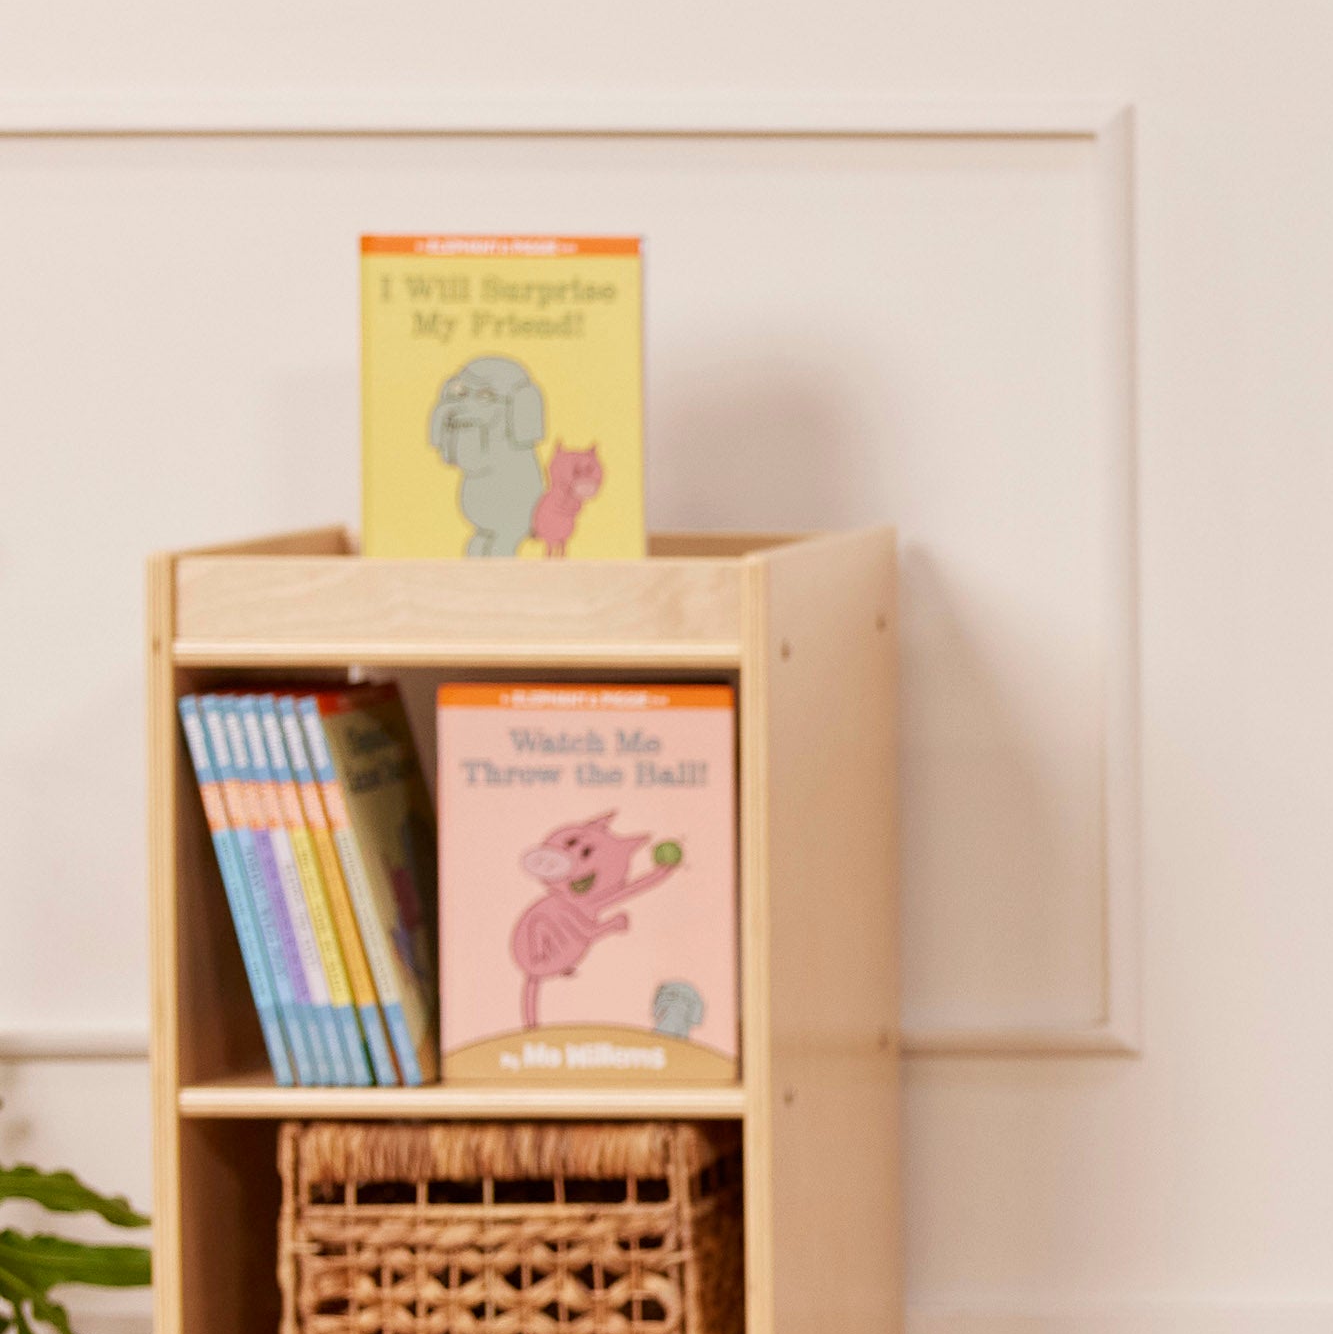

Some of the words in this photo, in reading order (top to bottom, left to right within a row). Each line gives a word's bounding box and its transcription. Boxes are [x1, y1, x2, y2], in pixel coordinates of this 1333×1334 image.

[379, 275, 393, 302] I
[405, 275, 472, 302] Will
[480, 275, 616, 309] Surprise
[411, 312, 458, 343] My
[470, 312, 586, 337] Friend!
[509, 729, 604, 753] Watch
[615, 728, 662, 753] Me
[461, 761, 563, 786] Throw
[576, 761, 624, 786] the
[635, 761, 709, 787] Ball!
